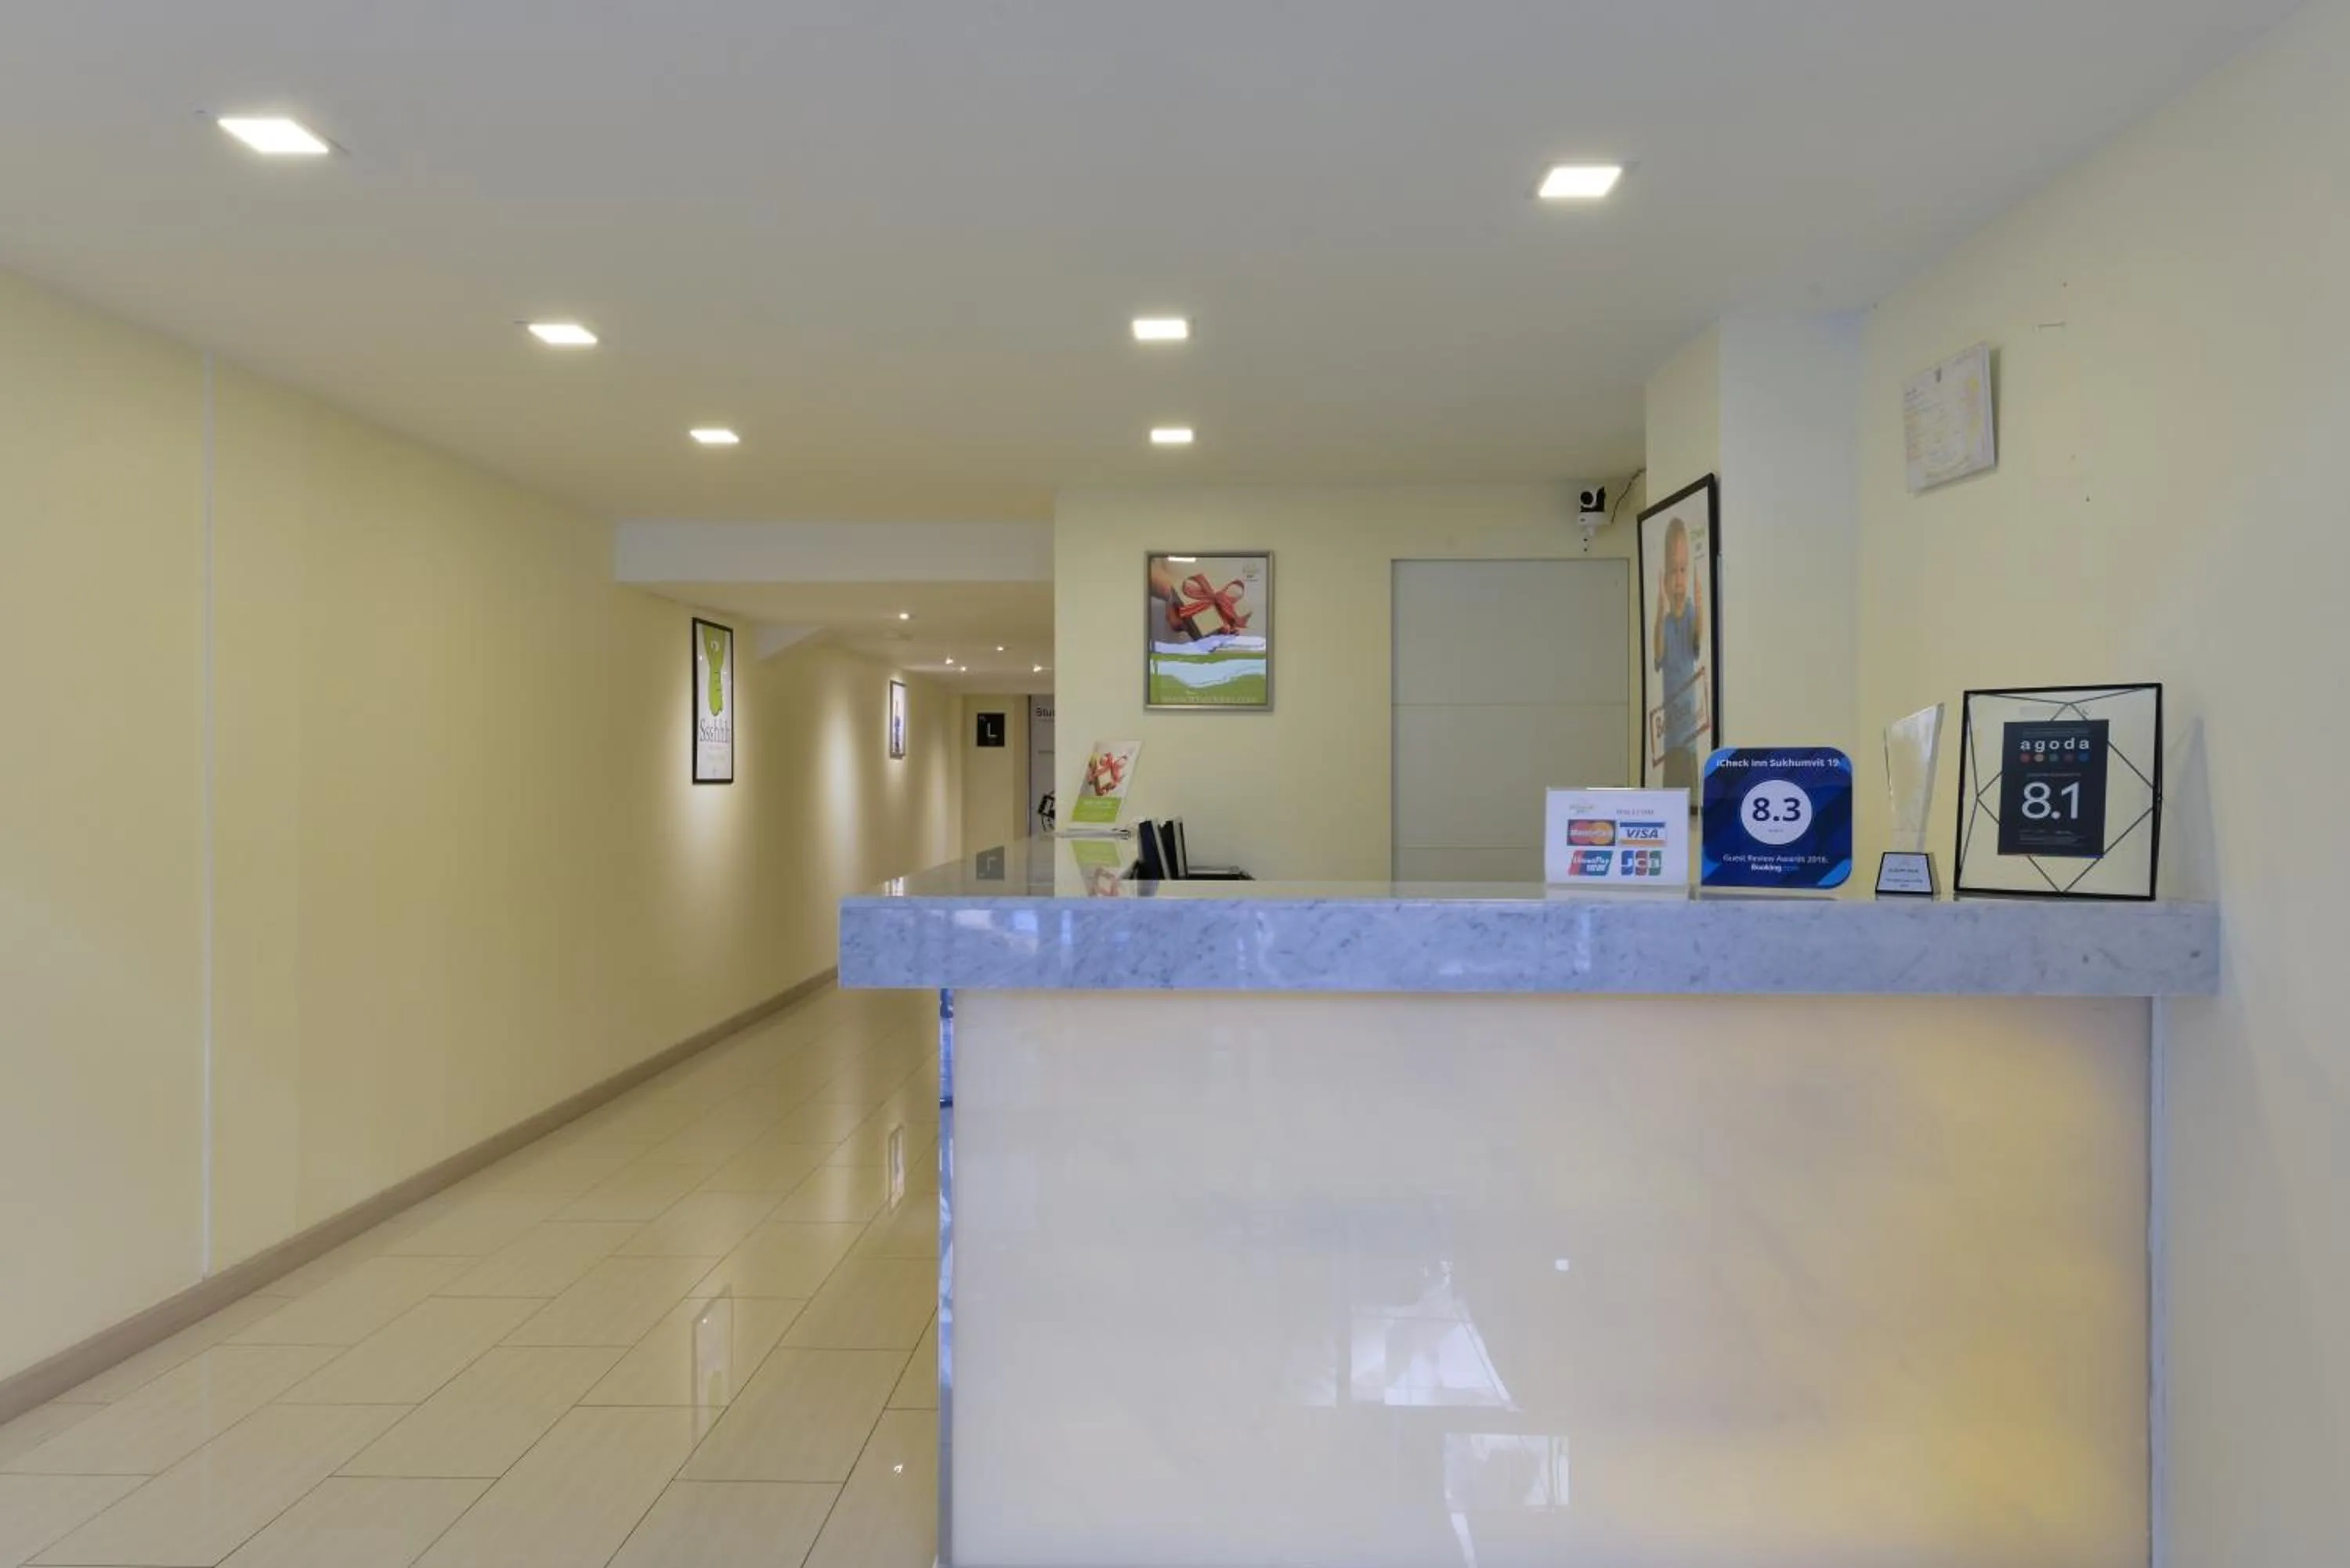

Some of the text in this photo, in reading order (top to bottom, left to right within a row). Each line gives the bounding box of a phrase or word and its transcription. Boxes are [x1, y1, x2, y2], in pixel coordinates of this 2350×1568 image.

[987, 722, 998, 738] L
[2019, 737, 2090, 753] agoda
[1716, 758, 1749, 767] iCheck
[1770, 758, 1824, 767] Sukhumvit
[2021, 782, 2080, 819] 8.1
[1752, 797, 1801, 821] 8.3
[1626, 829, 1658, 839] VISA
